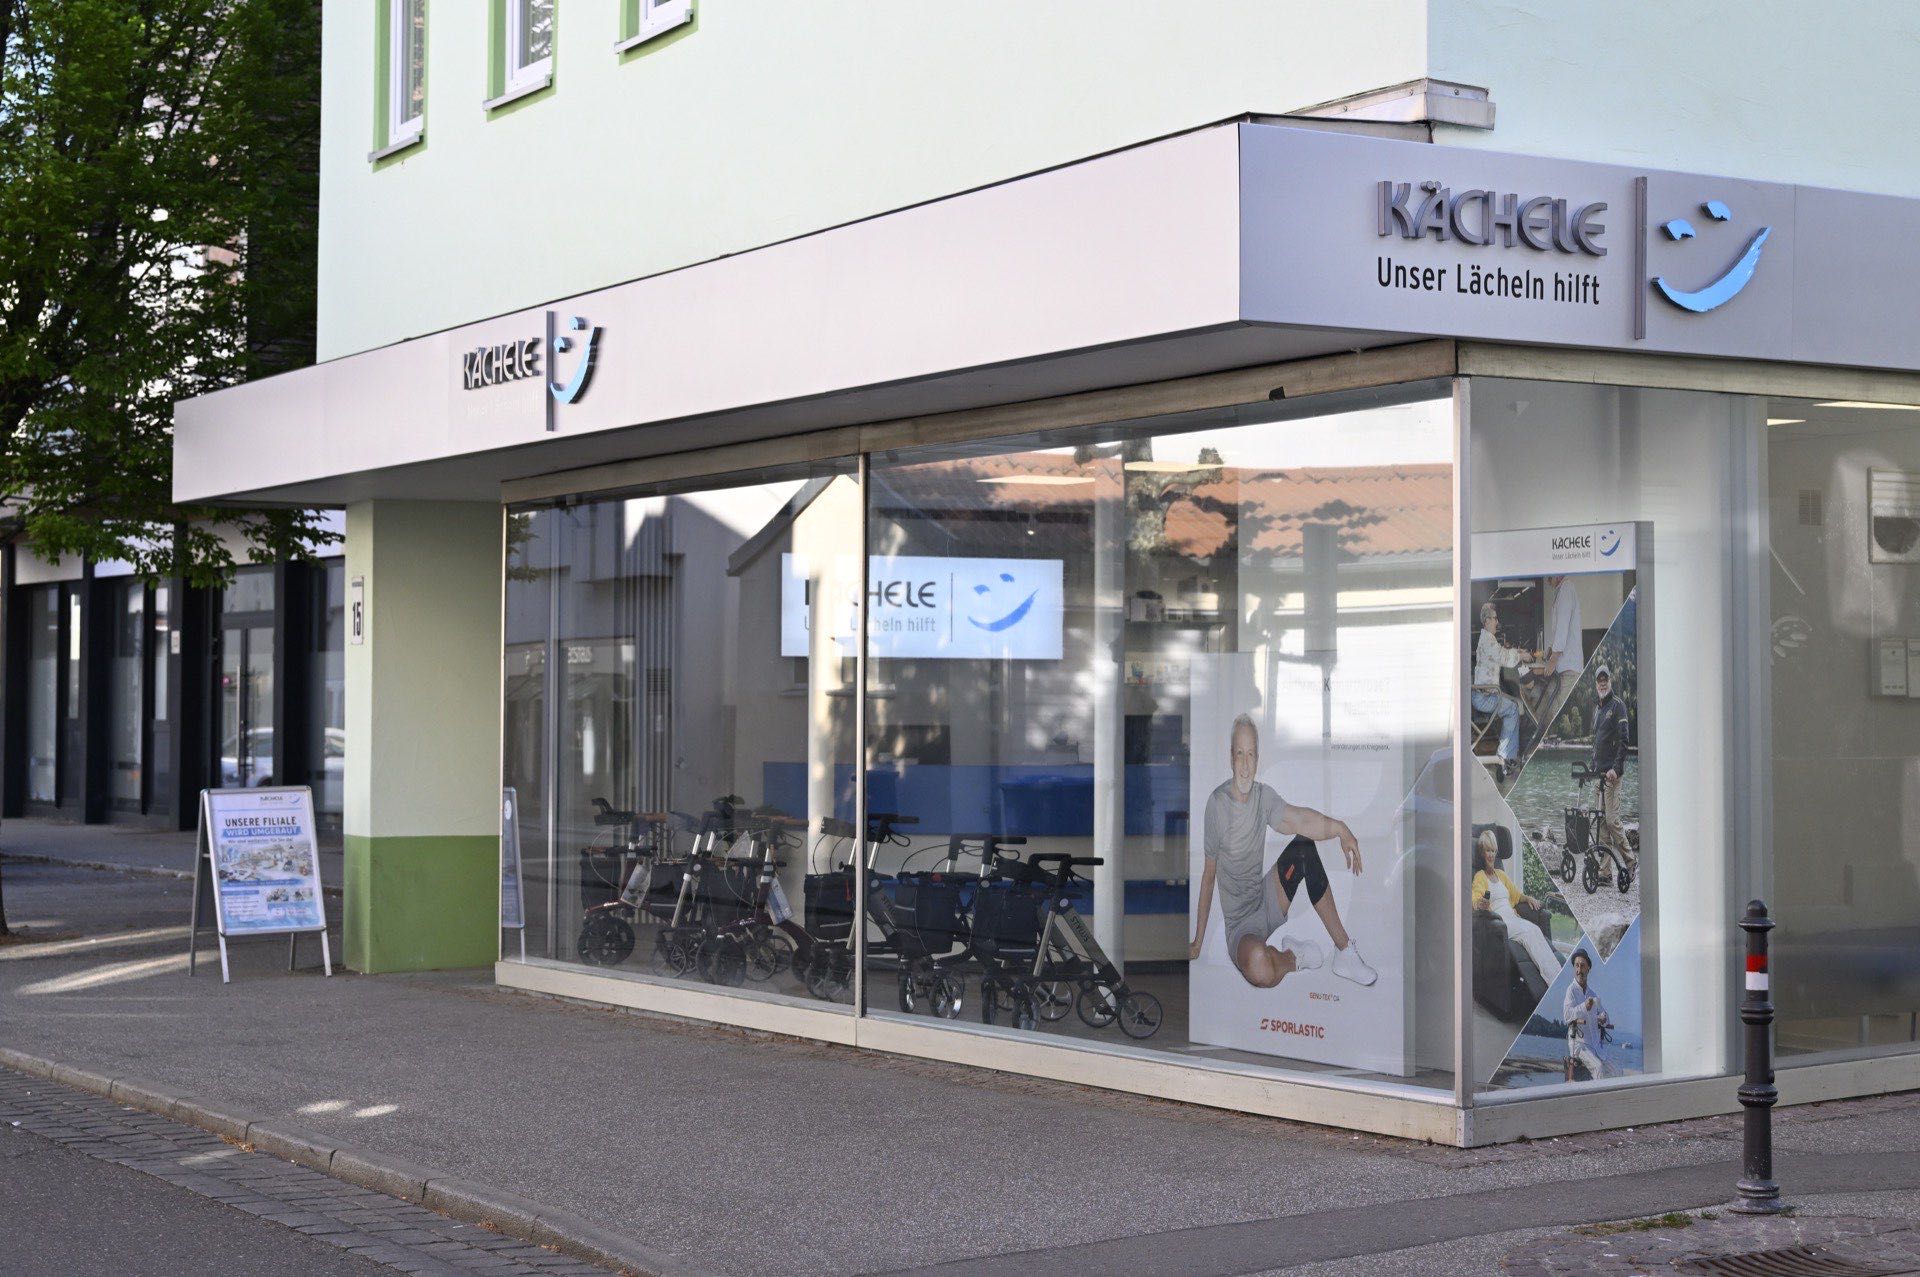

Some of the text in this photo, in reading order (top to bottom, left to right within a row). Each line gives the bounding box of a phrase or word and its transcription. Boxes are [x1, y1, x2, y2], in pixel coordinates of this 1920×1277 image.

[1378, 180, 1608, 257] KÄCHELE
[1378, 257, 1600, 305] Unser Lächeln hilft
[464, 337, 541, 390] KÄCHELE
[353, 602, 361, 636] 15
[907, 616, 936, 632] hilft
[225, 816, 296, 827] UNSERE FILIALE
[226, 826, 298, 837] WIRD UMGEBAUT
[1070, 915, 1090, 942] STYLUS
[1271, 1020, 1324, 1038] SPORLASTIC
